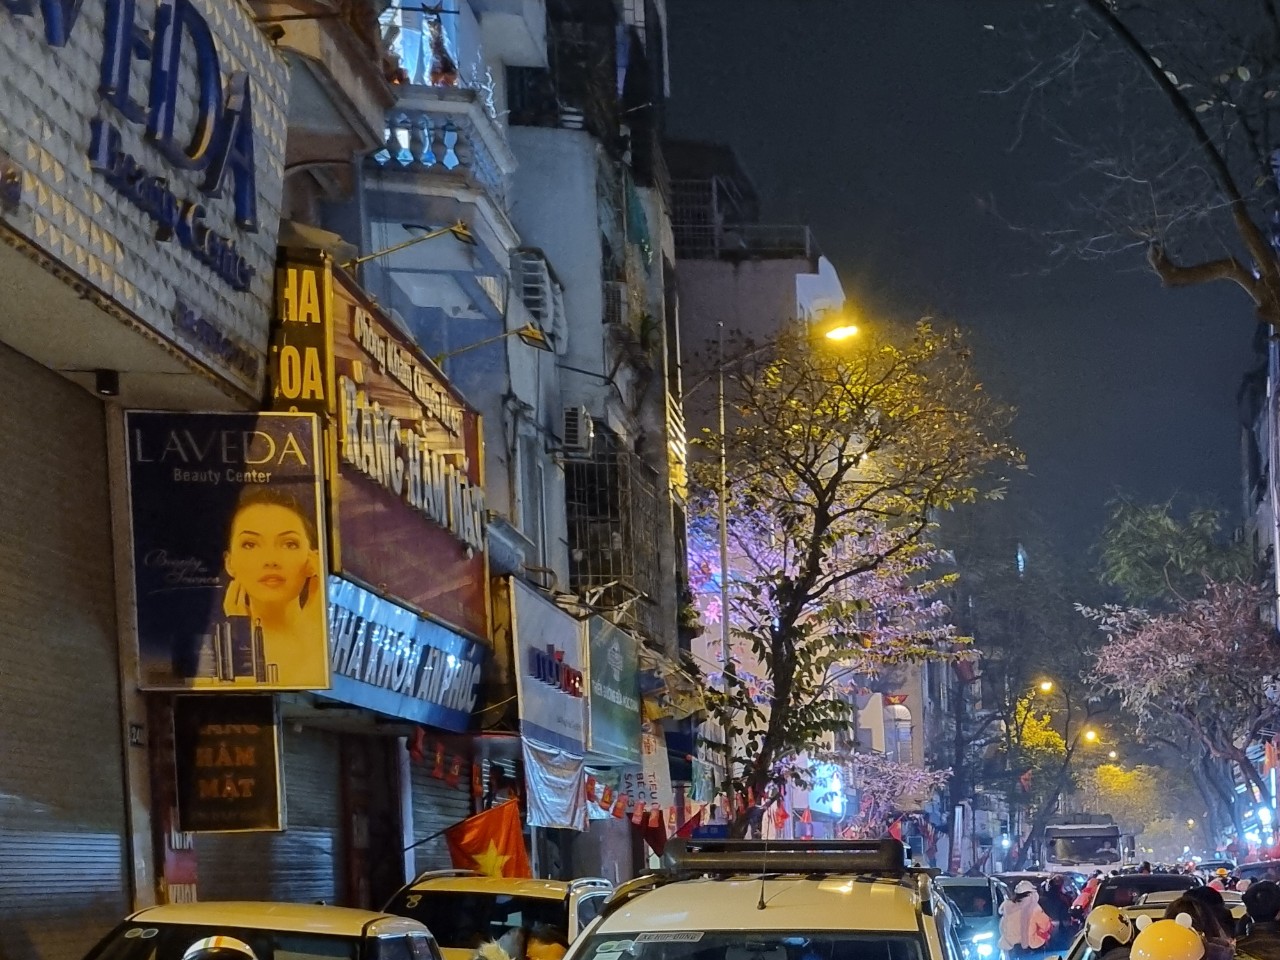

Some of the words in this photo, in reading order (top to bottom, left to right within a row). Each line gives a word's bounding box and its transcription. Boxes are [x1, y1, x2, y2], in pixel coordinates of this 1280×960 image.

[136, 428, 308, 466] LAVEDA
[173, 468, 221, 485] Beauty
[225, 468, 272, 484] Center
